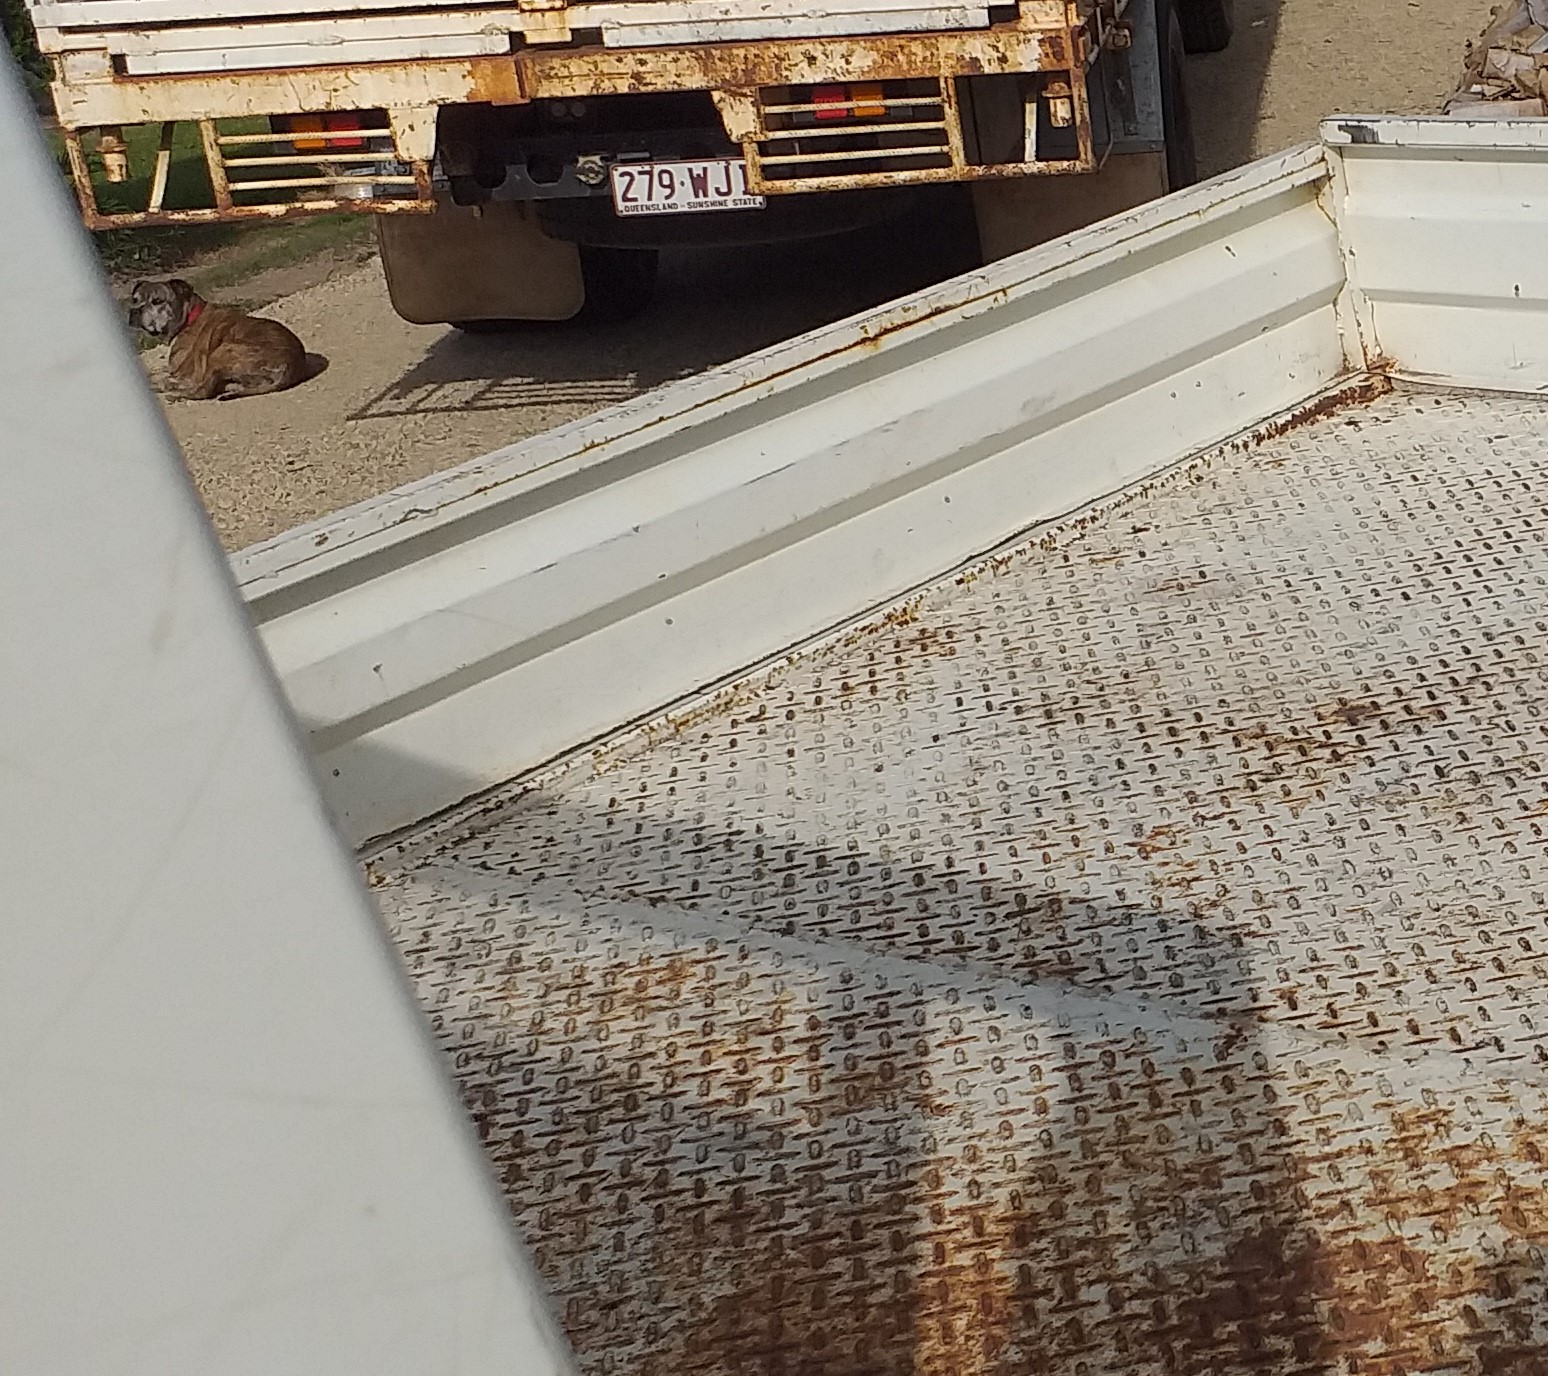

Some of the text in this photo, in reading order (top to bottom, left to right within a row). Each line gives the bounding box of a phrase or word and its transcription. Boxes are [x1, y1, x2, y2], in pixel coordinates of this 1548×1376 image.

[624, 203, 679, 213] QUEENSLAND
[686, 199, 729, 210] SUNSHINE
[732, 198, 758, 207] STATE
